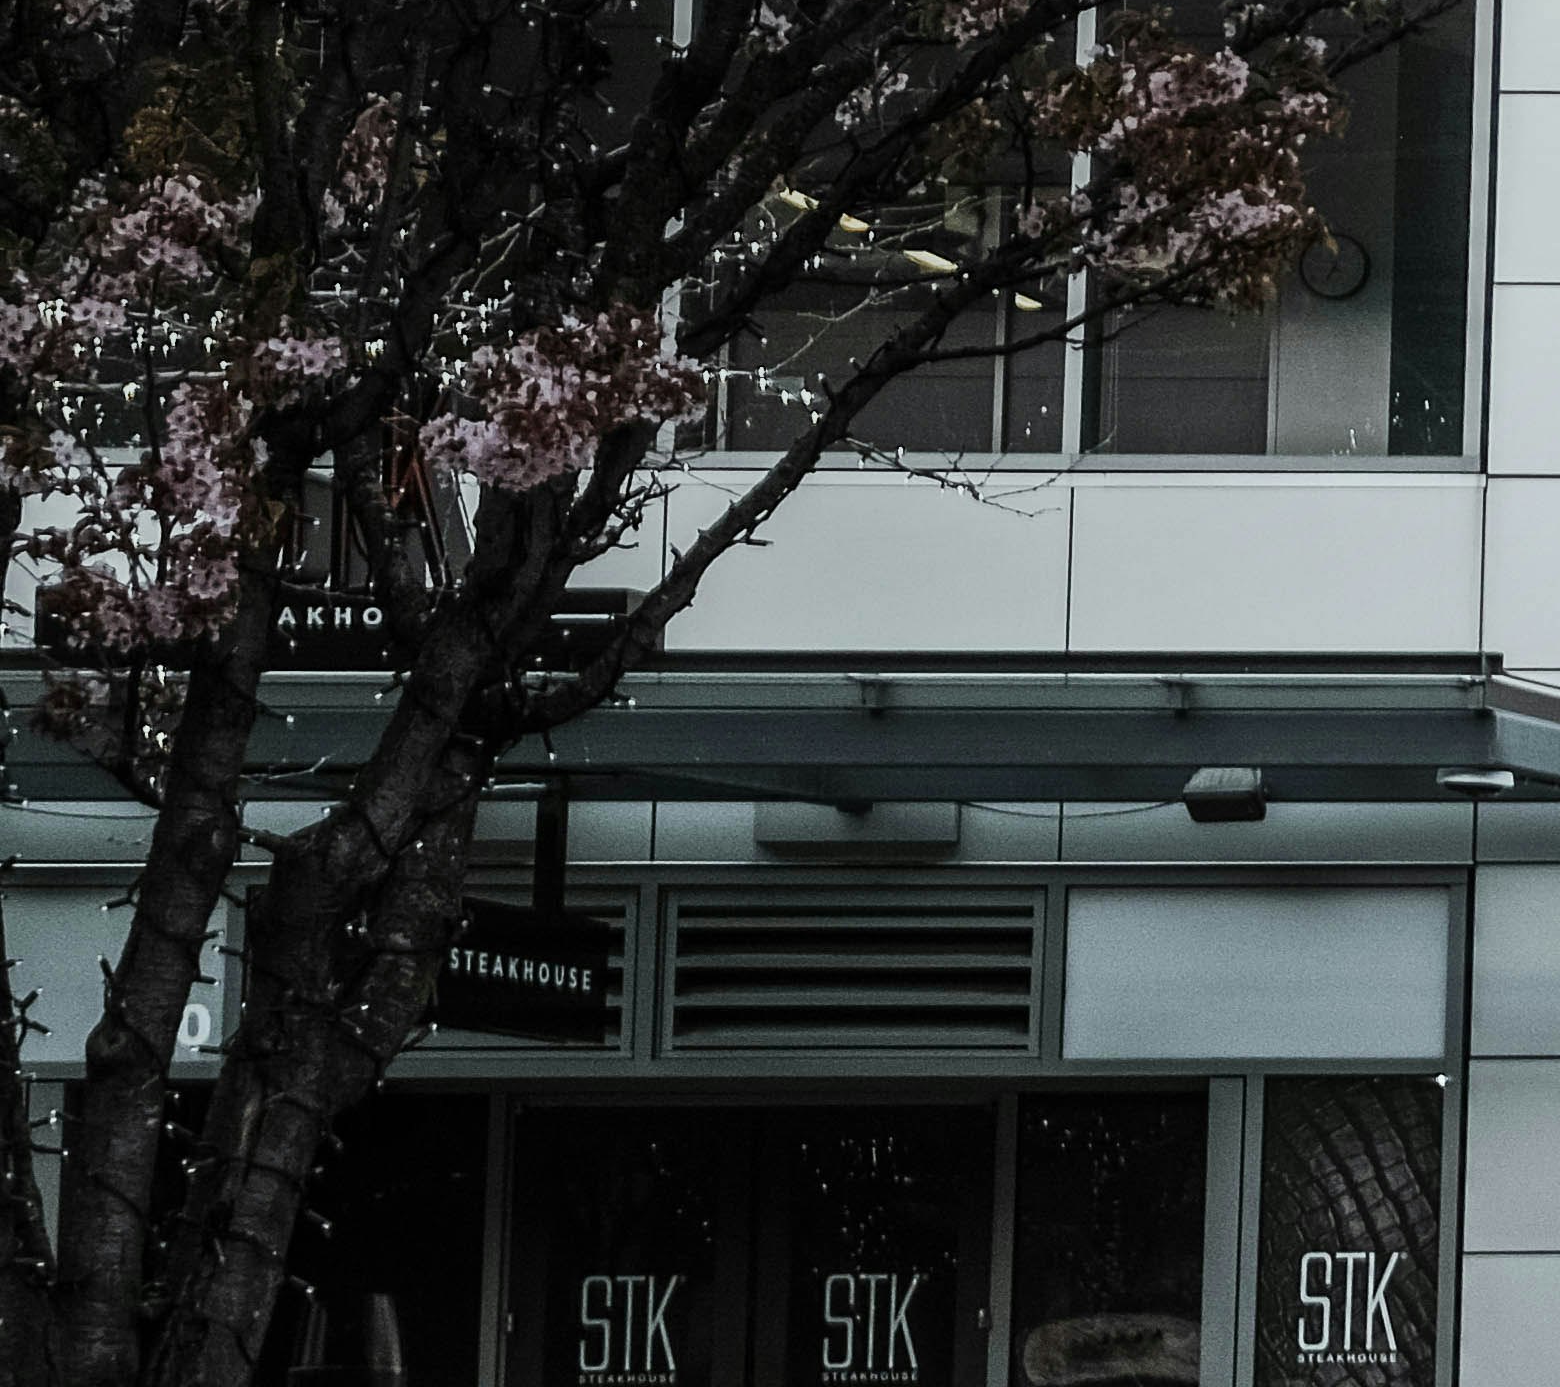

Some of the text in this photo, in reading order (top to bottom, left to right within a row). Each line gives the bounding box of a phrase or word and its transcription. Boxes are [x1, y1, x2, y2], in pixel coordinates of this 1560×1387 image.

[450, 946, 592, 991] STEAKHOUSE
[579, 1275, 678, 1371] STK
[823, 1273, 920, 1369] STK
[1298, 1251, 1400, 1352] STK
[1297, 1353, 1397, 1364] STEAKHOUSE
